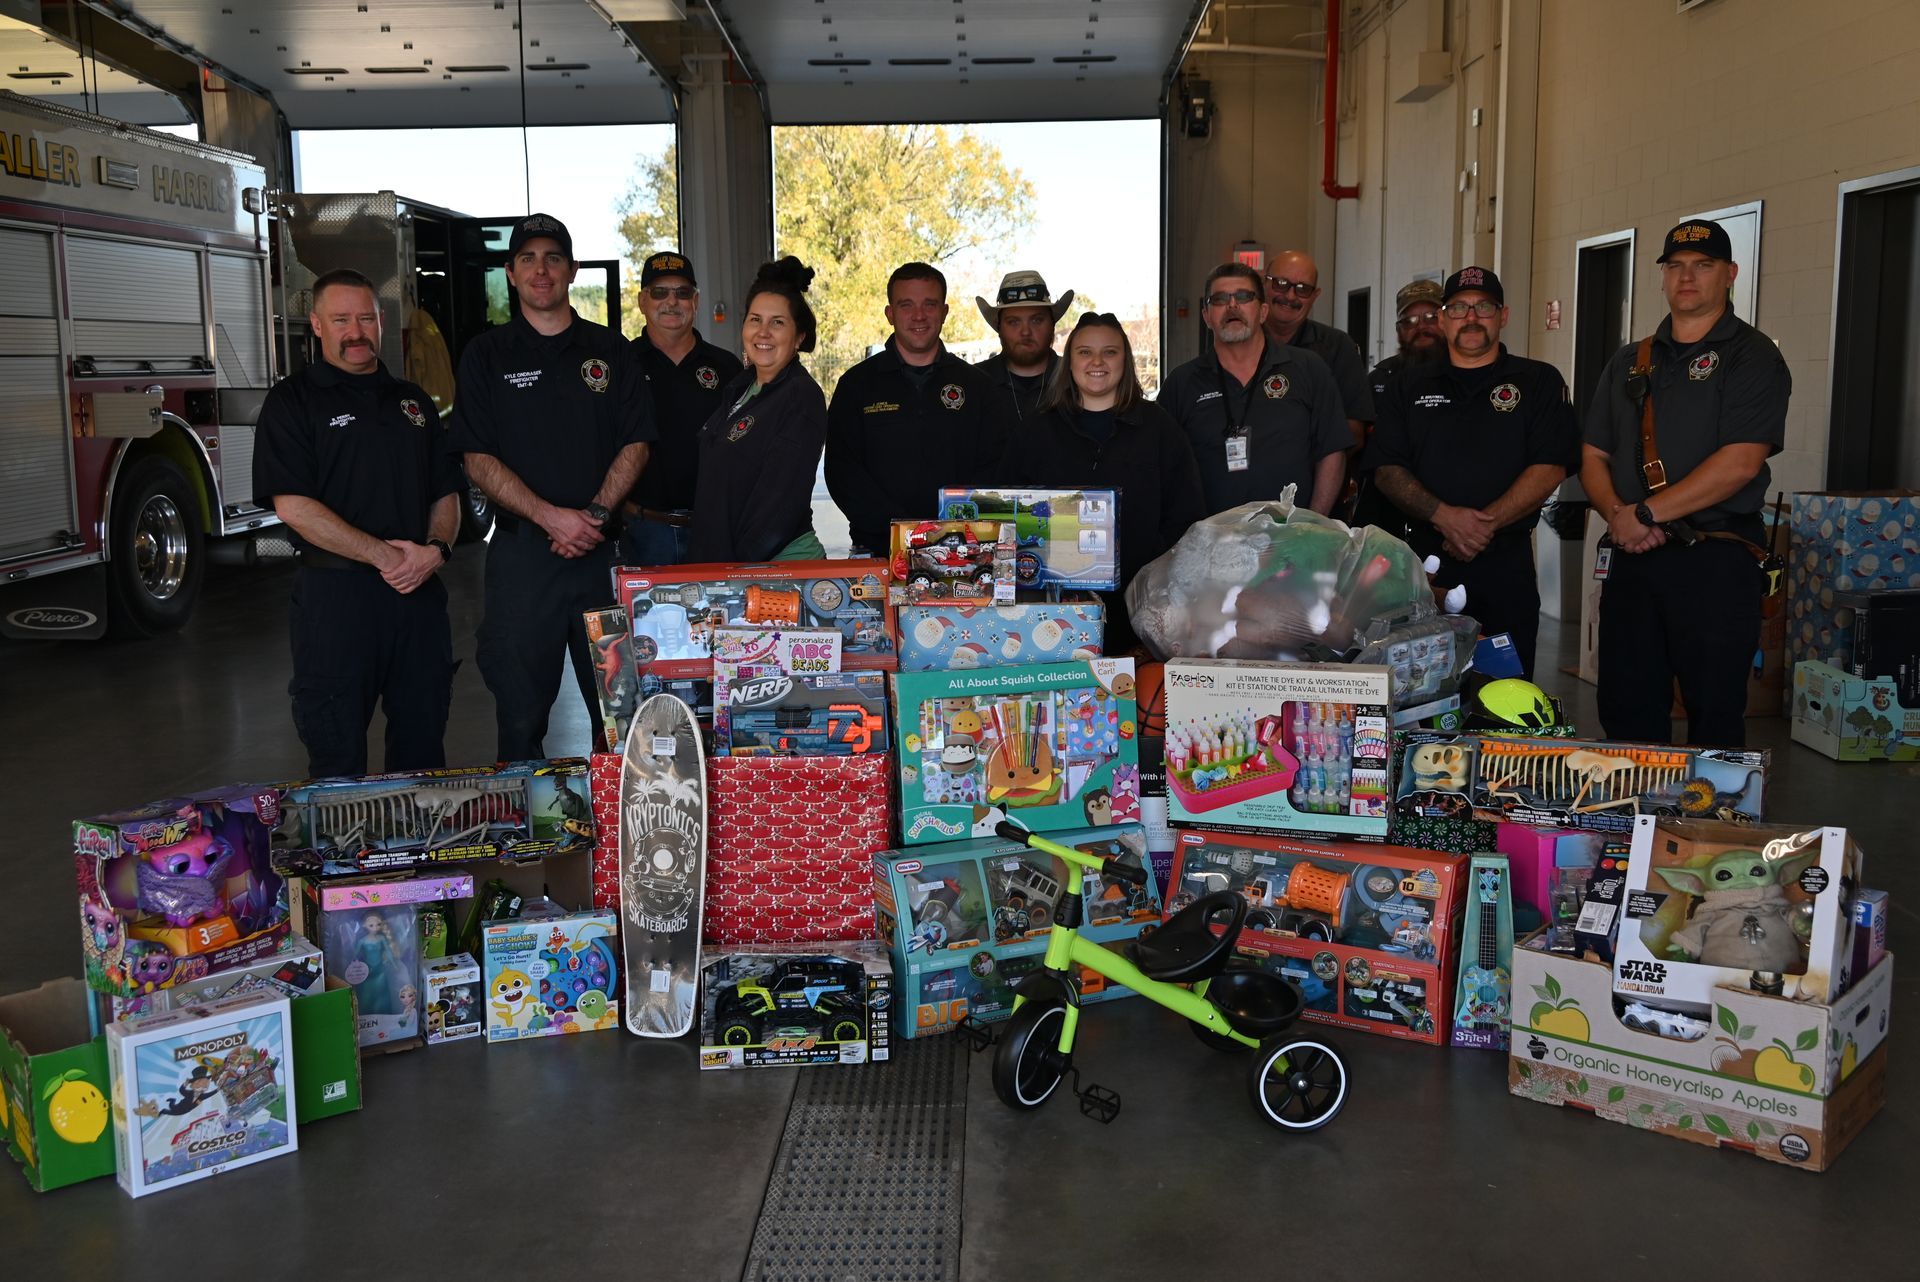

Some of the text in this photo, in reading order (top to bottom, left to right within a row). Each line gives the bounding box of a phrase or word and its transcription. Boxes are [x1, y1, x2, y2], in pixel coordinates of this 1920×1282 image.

[0, 131, 229, 212] ALLER HARRIS
[852, 588, 863, 596] 10
[23, 610, 80, 624] Pierce
[789, 636, 834, 644] personalized
[791, 644, 832, 659] ABC
[791, 659, 829, 671] BEADS
[1097, 660, 1116, 668] Meet
[1097, 667, 1115, 676] Carl!
[816, 677, 824, 687] 6
[948, 670, 1087, 689] All About Squish Collection
[1316, 678, 1368, 687] WORKSTATION
[729, 678, 790, 705] NERF
[1247, 683, 1276, 691] STATION
[1289, 685, 1316, 693] TRAVAIL
[1319, 686, 1352, 694] ULTIMATE
[1356, 706, 1368, 715] 24
[1904, 712, 1920, 721] CRU
[1903, 722, 1920, 730] MUN
[259, 795, 276, 807] 50+
[625, 802, 701, 849] KRYPTONICS
[1152, 859, 1174, 868] uper
[1402, 882, 1414, 892] 10
[629, 900, 689, 934] SKATEBOARDS
[200, 928, 210, 945] 3
[489, 934, 538, 945] BABY SHARK'S
[489, 941, 536, 952] BIG SHOW!
[1620, 960, 1667, 974] STAR
[1620, 969, 1667, 983] WARS
[917, 998, 968, 1028] BIG
[177, 1034, 245, 1059] MONOPOLY
[1554, 1047, 1798, 1117] Organic Honeycrisp Apples
[188, 1131, 246, 1153] COSTCO
[207, 1140, 245, 1153] WHOLESALE
[1786, 1140, 1804, 1148] USDA
